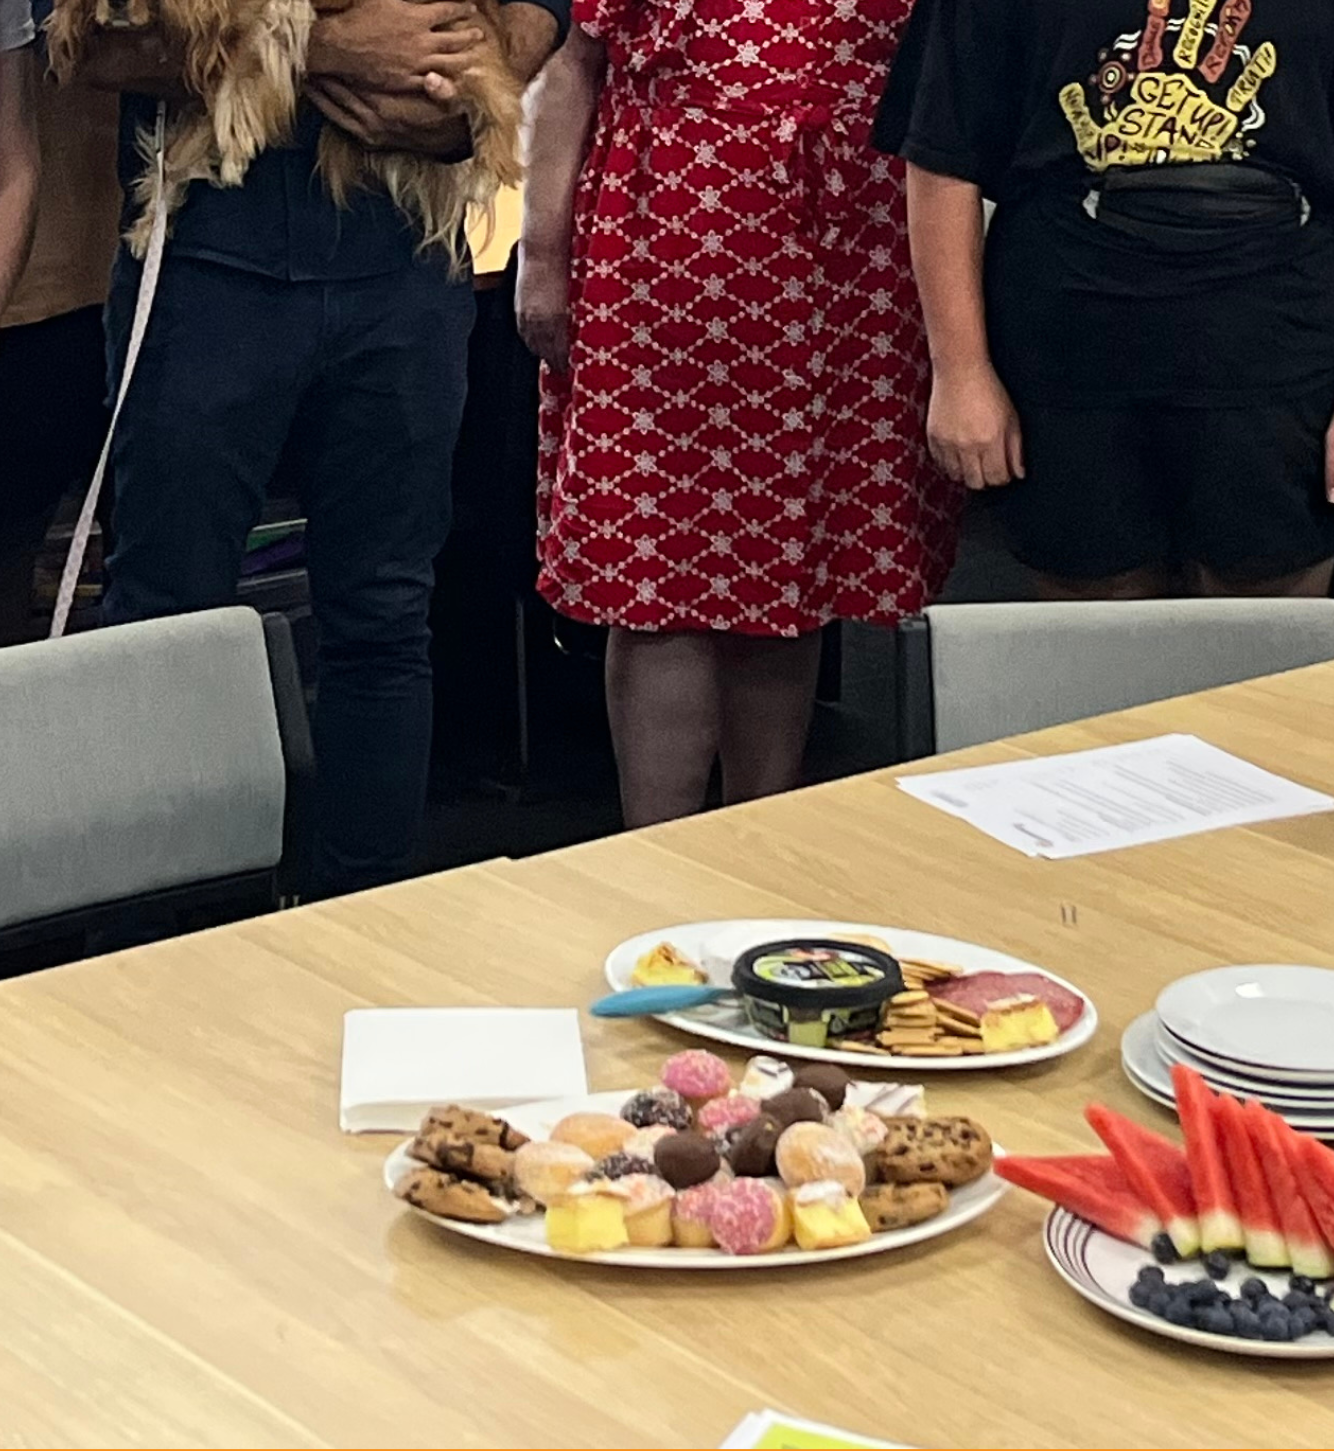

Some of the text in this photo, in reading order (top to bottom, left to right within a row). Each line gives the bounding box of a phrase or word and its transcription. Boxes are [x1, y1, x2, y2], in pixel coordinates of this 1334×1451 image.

[1118, 107, 1216, 149] STAND
[1137, 76, 1201, 116] GET
[1189, 102, 1232, 142] UP!
